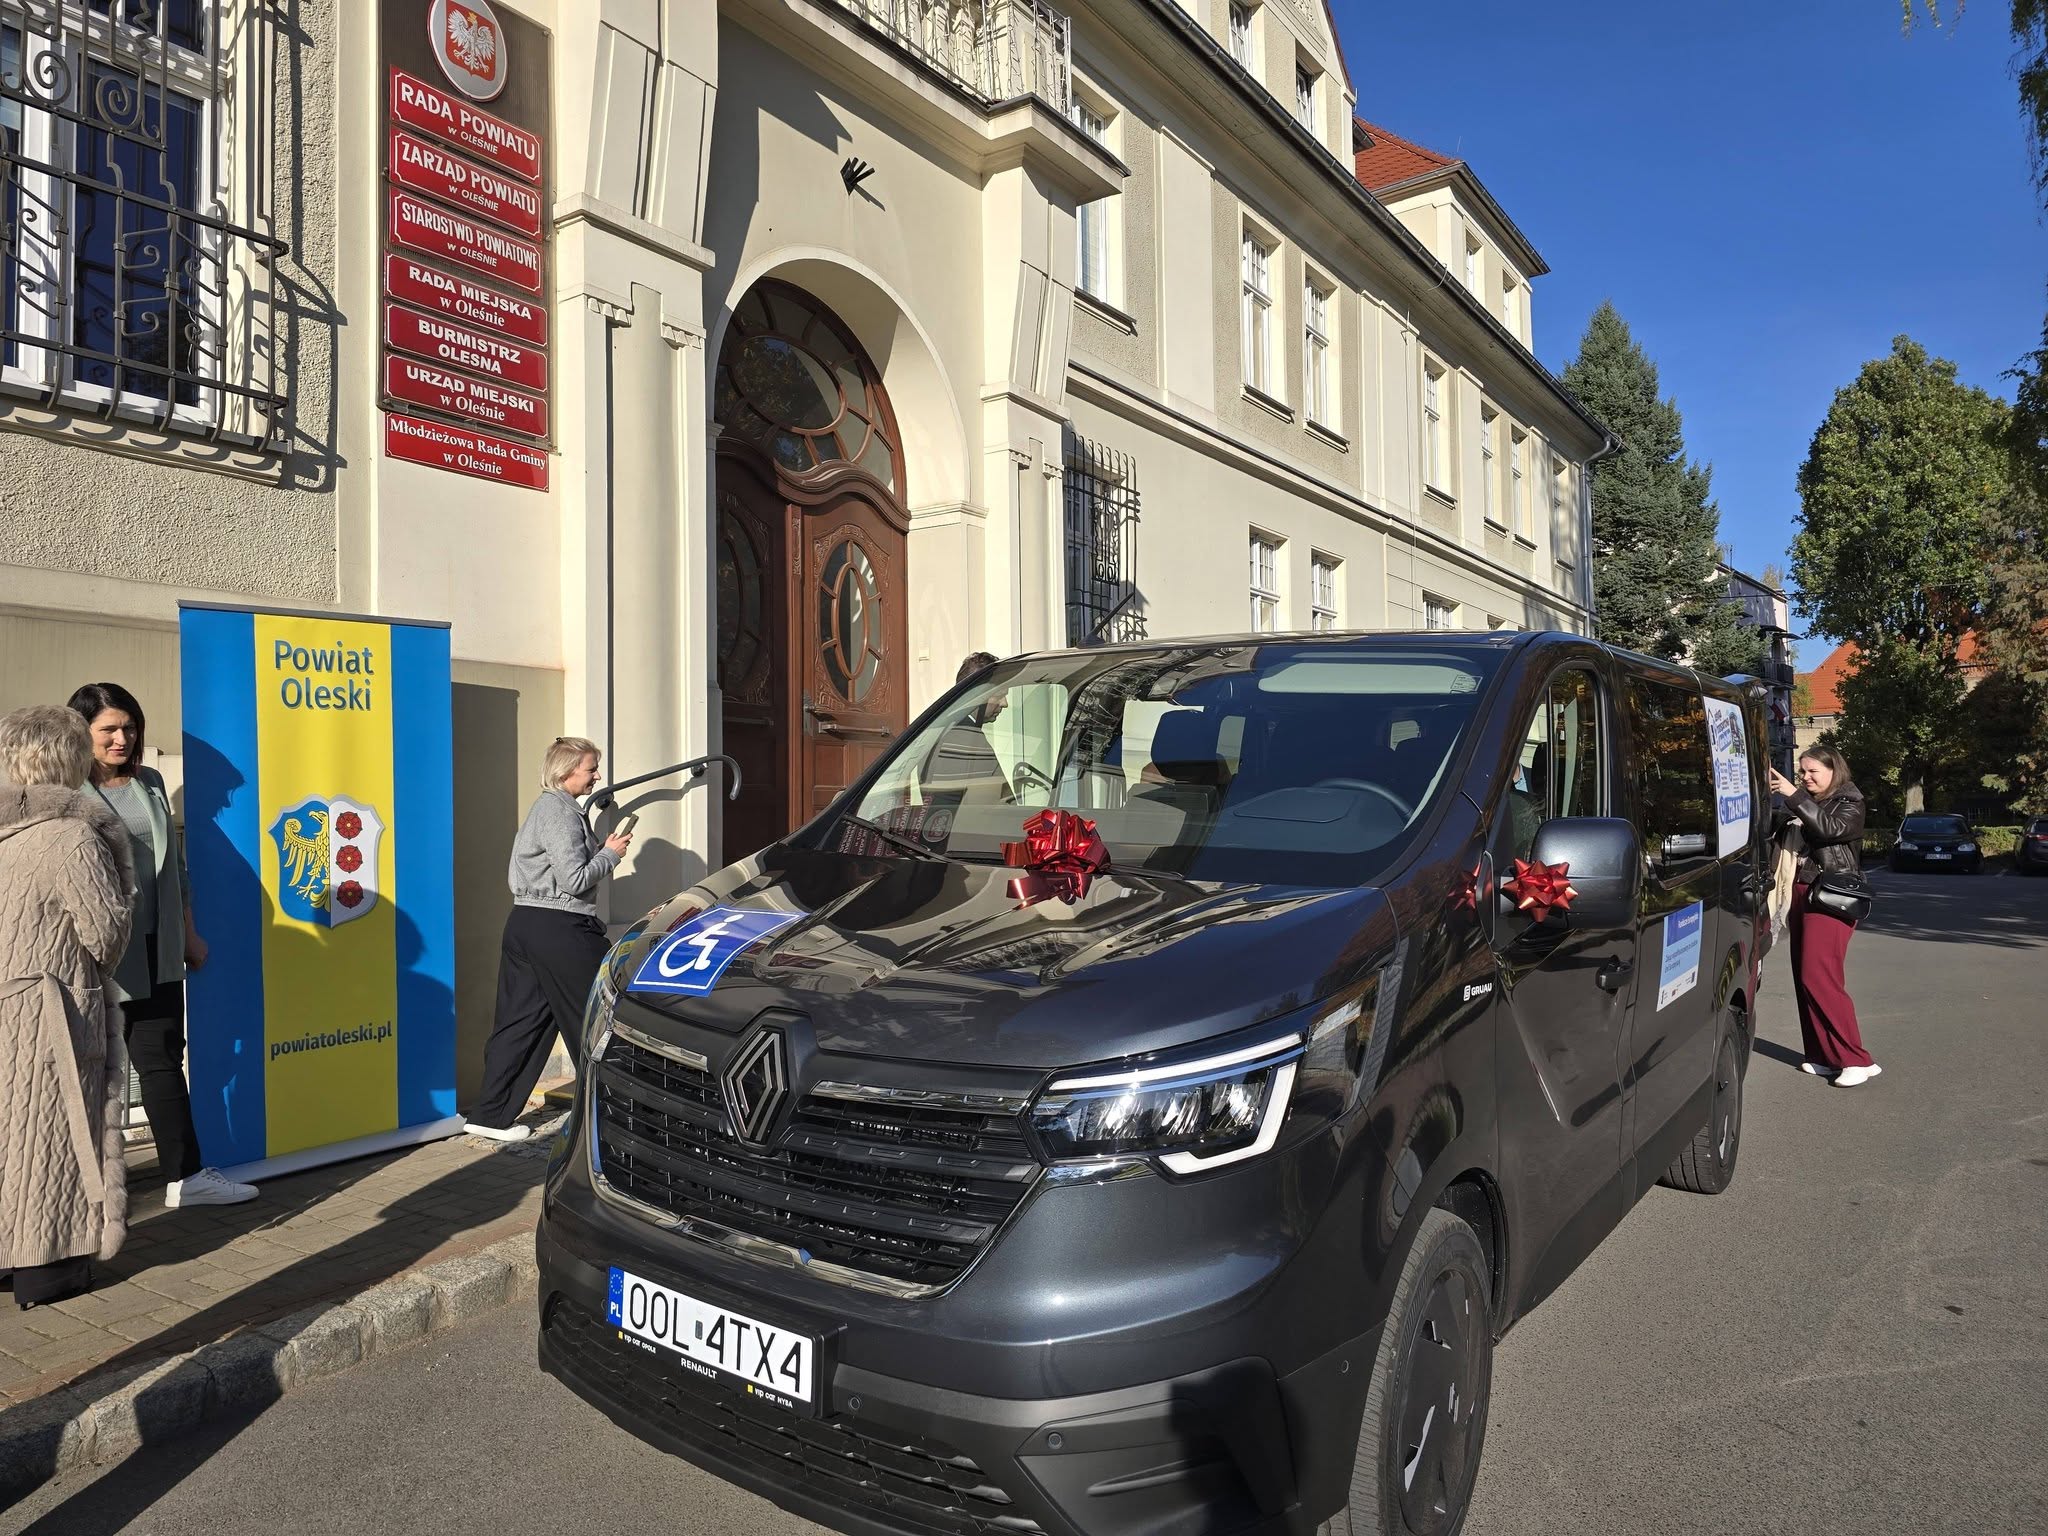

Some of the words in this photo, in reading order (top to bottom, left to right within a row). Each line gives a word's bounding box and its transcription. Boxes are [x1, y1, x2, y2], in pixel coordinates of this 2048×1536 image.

[401, 82, 453, 122] RADA
[460, 108, 535, 161] POWIATU
[460, 131, 498, 155] OLEŚNIE
[401, 141, 466, 184] ZARZĄD
[470, 172, 536, 215] POWIATU
[461, 189, 499, 212] OLEŚNIE
[401, 201, 474, 244] STAROSTWO
[476, 229, 537, 271] POWIATOWE
[459, 245, 498, 268] OLEŚNIE
[409, 265, 457, 294] RADA
[461, 284, 532, 320] MIEJSKA
[439, 296, 452, 308] w
[455, 300, 505, 327] Oleśnie
[418, 319, 521, 364] BURMISTRZ
[438, 343, 502, 374] OLESNA
[406, 365, 465, 394] URZĄD
[470, 383, 534, 413] MIEJSKI
[439, 394, 452, 405] w
[455, 397, 505, 421] Oleśnie
[389, 418, 474, 450] Młodzieżowa
[477, 439, 507, 458] Rada
[510, 449, 546, 470] Gminy
[442, 451, 454, 463] w
[457, 454, 502, 474] Oleśnie
[273, 640, 374, 676] Powiat
[280, 678, 372, 712] Oleski
[1471, 982, 1493, 996] GRUAU
[270, 1025, 393, 1060] powiatoleski.pl
[610, 1301, 621, 1318] PL
[629, 1282, 689, 1351] OOL
[705, 1314, 802, 1394] 4TX4
[681, 1357, 718, 1380] RENAULT
